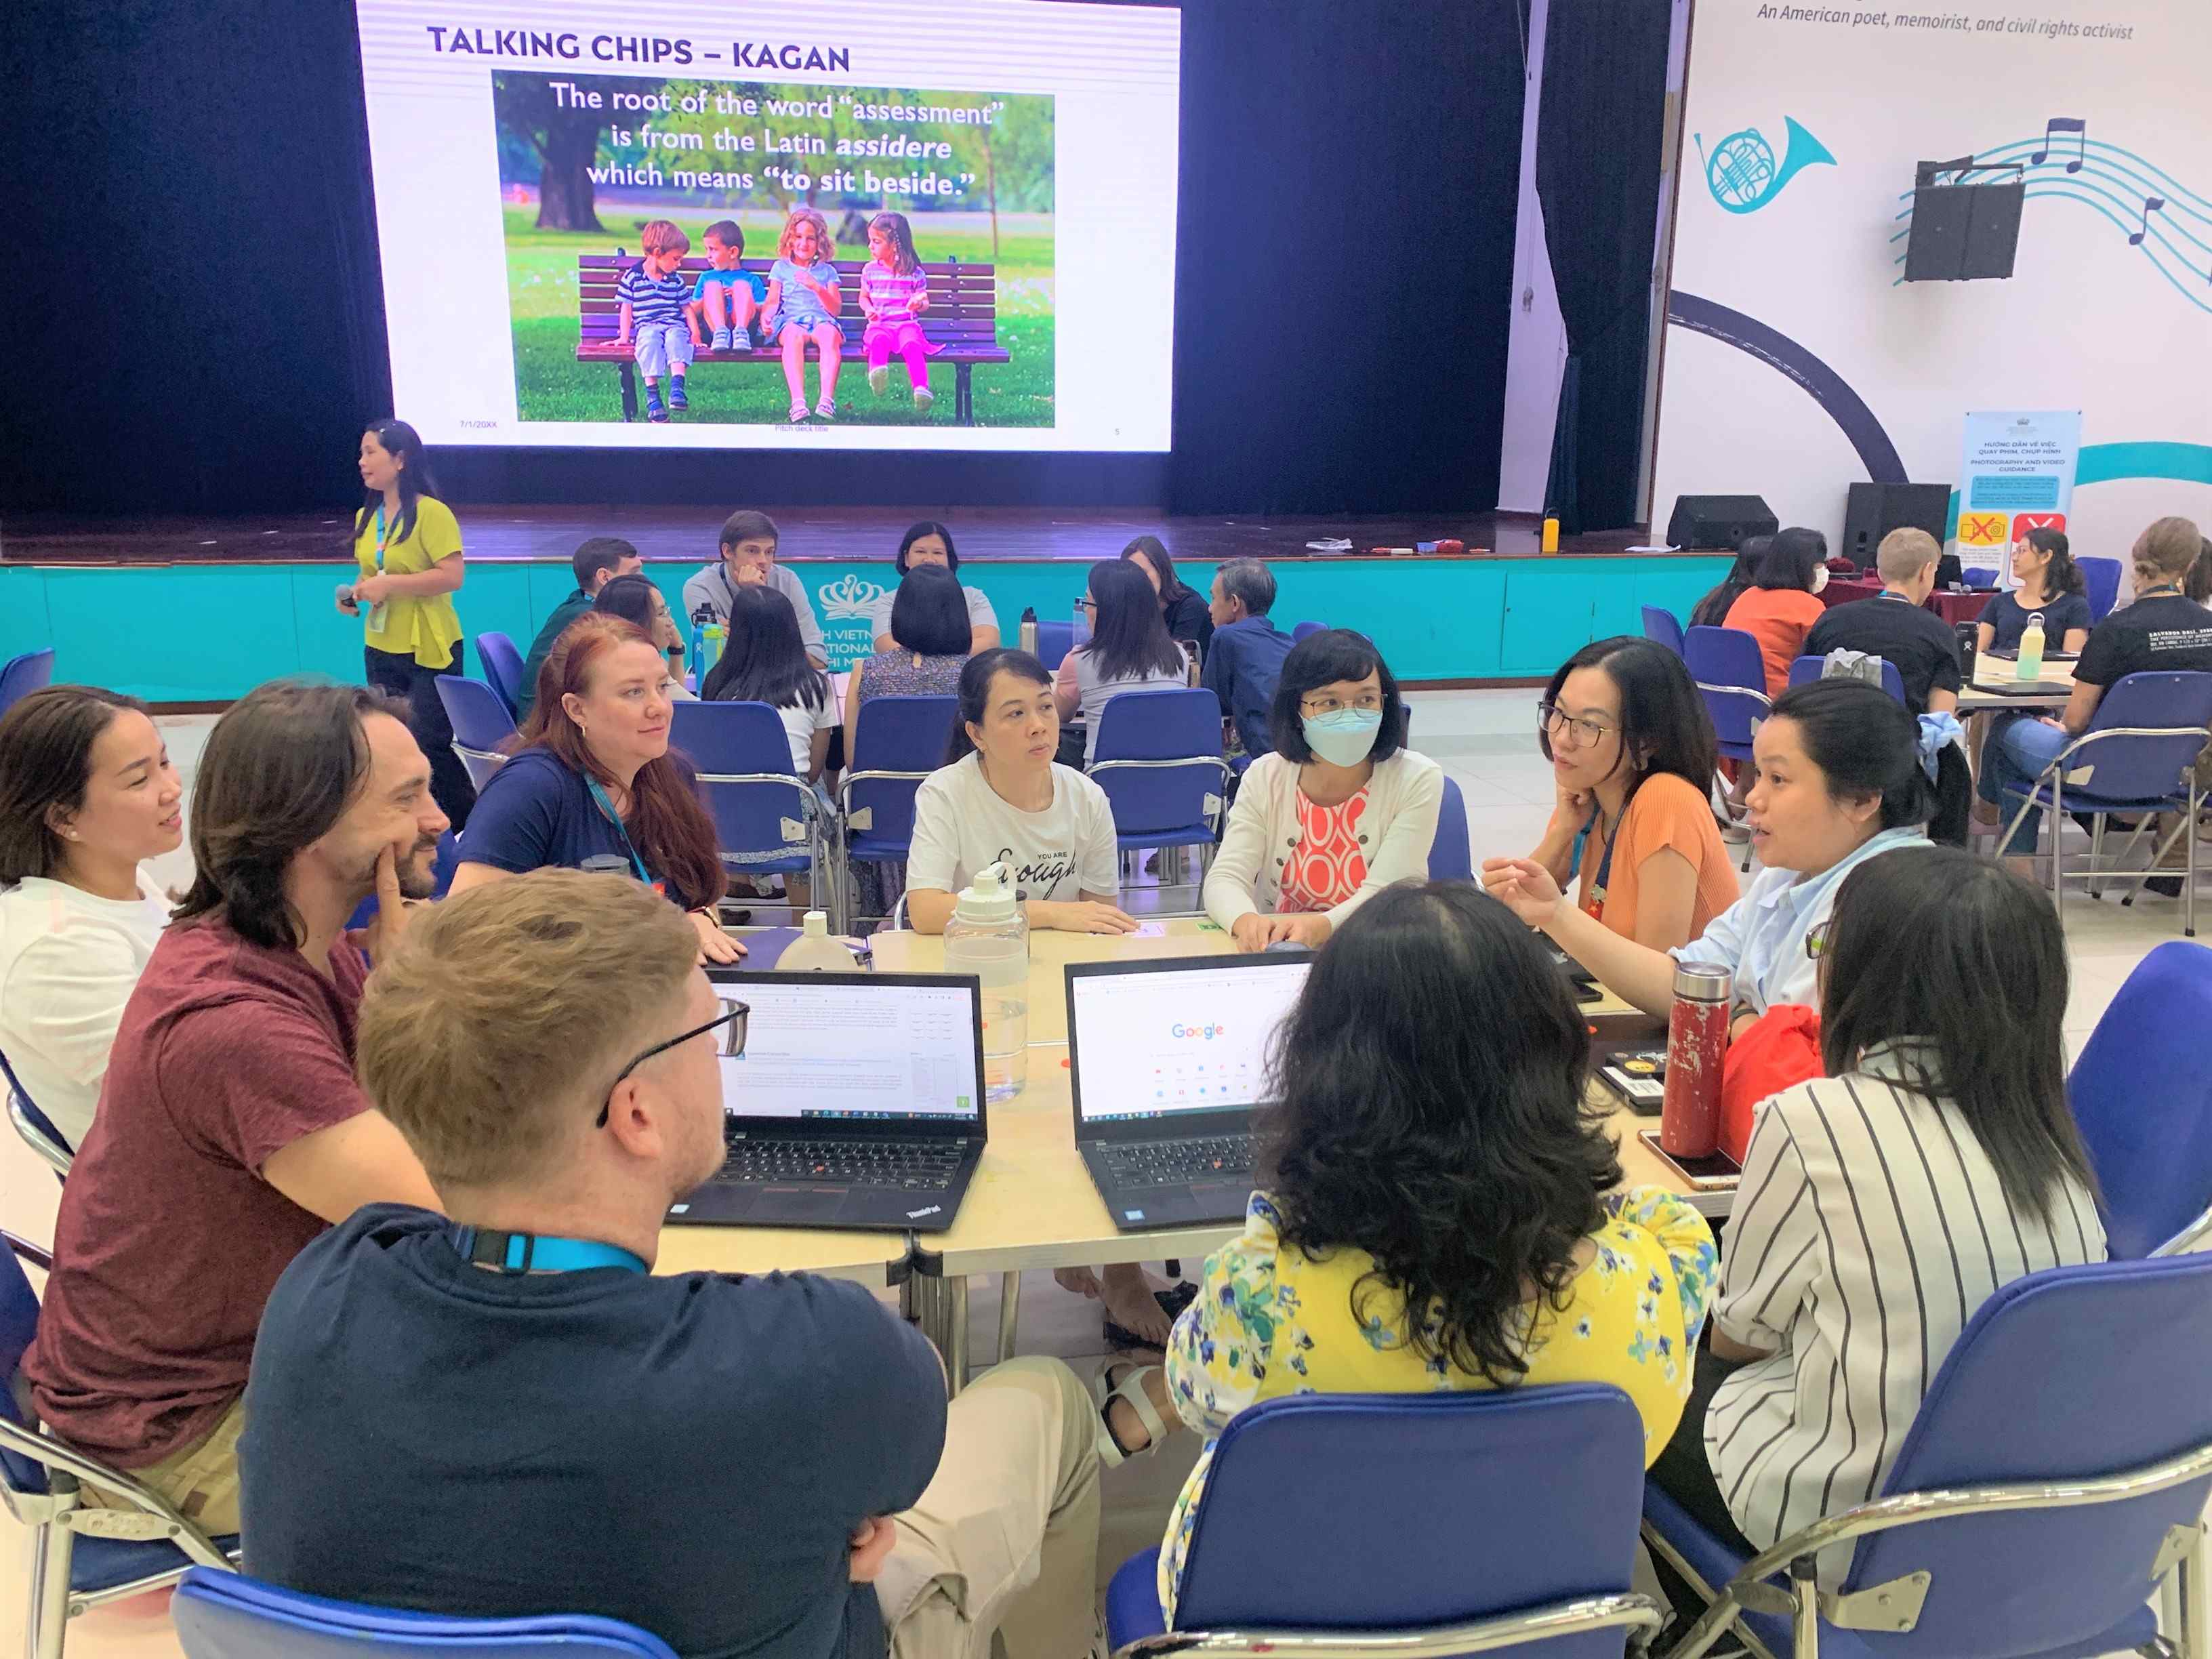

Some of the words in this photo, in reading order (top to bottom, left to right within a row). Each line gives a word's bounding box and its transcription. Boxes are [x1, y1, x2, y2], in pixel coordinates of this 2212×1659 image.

[1757, 4, 1777, 19] An
[1780, 5, 1850, 23] American
[1852, 11, 1889, 28] poet,
[1894, 14, 1971, 32] memoirist,
[1976, 16, 2005, 32] and
[2007, 18, 2036, 34] civil
[2039, 20, 2079, 39] rights
[2082, 23, 2133, 39] activist
[427, 26, 580, 60] TALKING
[591, 35, 693, 66] CHIPS
[733, 43, 850, 73] KAGAN
[550, 81, 602, 108] The
[613, 92, 672, 113] root
[681, 89, 708, 113] of
[715, 90, 758, 115] the
[766, 96, 832, 119] word
[612, 125, 632, 147] is
[640, 124, 703, 150] from
[713, 127, 755, 152] the
[765, 129, 826, 155] Latin
[835, 134, 951, 159] assidere
[586, 161, 663, 186] which
[674, 170, 754, 189] means
[820, 169, 855, 192] sit
[460, 419, 498, 429] 7/1/20XX
[775, 423, 794, 432] Pitch
[795, 422, 813, 432] deck
[815, 423, 829, 432] title
[1172, 1022, 1224, 1040] Google
[906, 1204, 941, 1219] ThinkPad
